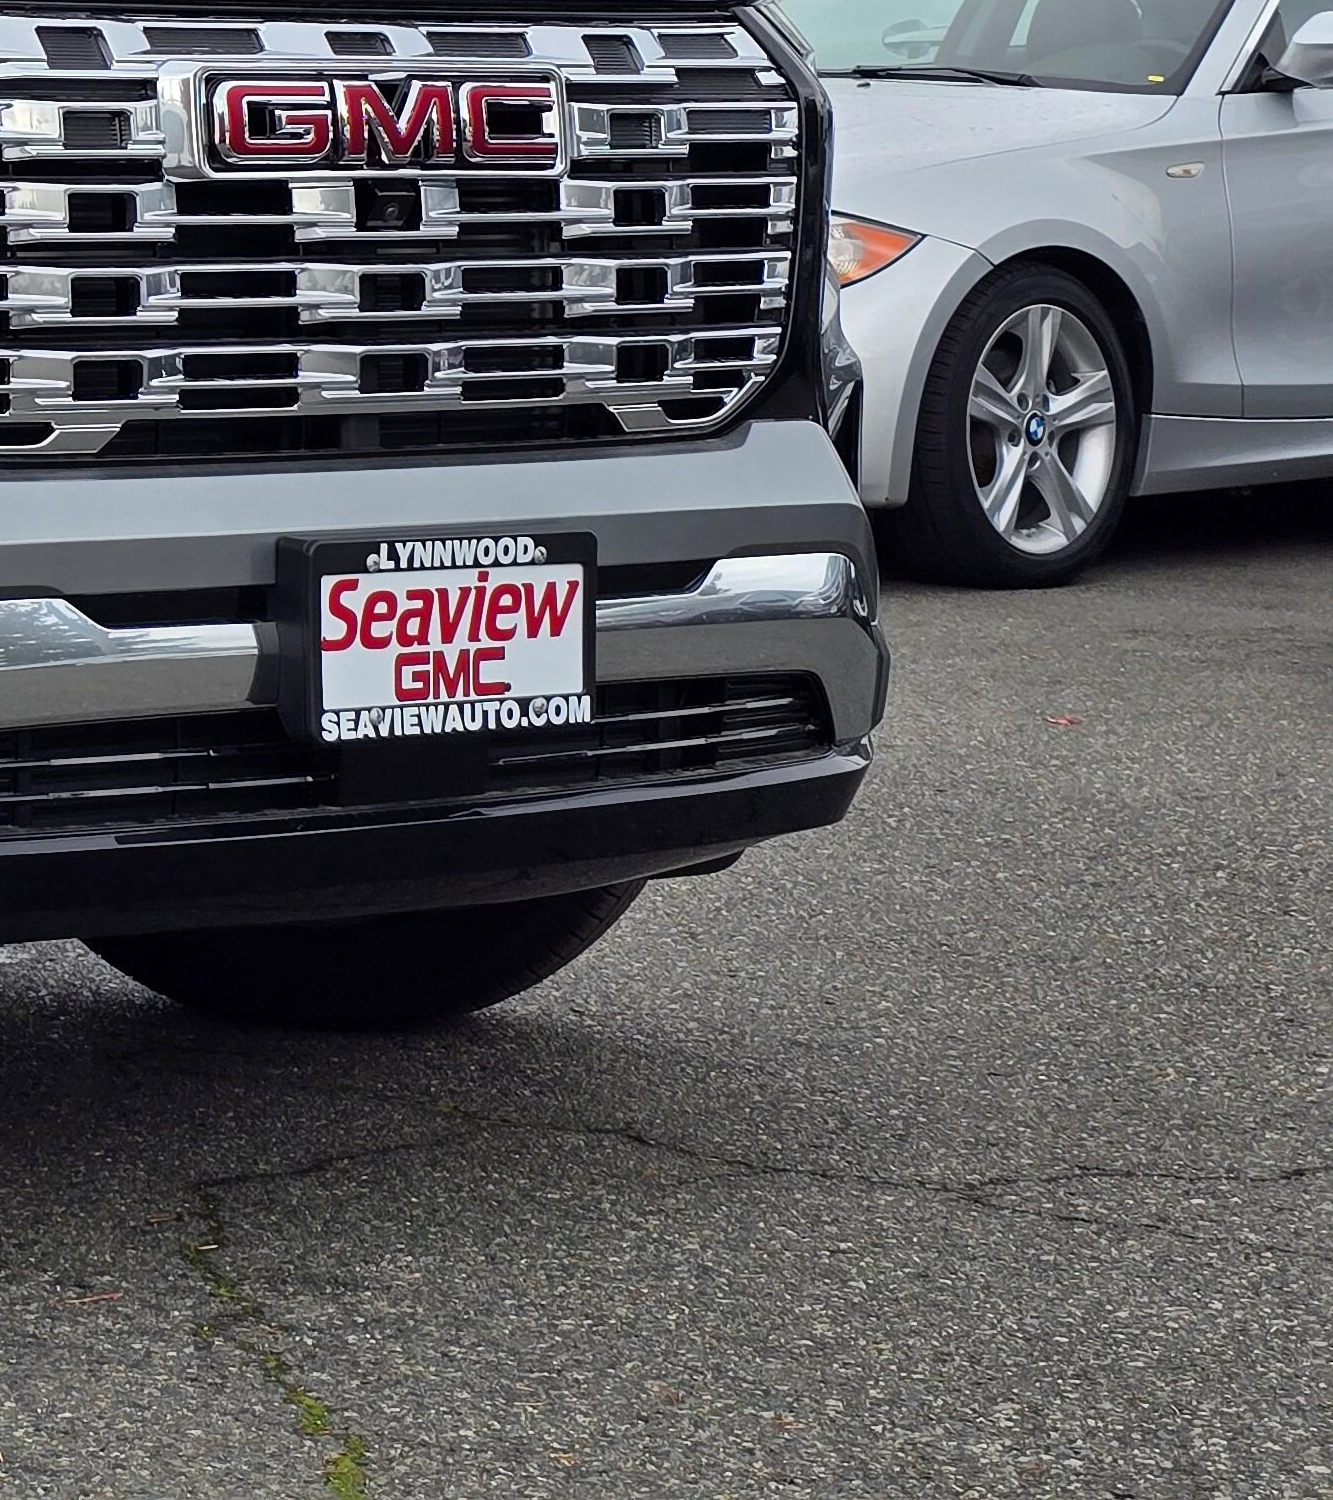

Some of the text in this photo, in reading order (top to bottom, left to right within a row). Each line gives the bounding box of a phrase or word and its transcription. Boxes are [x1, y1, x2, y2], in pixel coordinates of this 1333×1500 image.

[213, 79, 559, 165] GMC
[379, 537, 536, 570] LYNNWOOD
[320, 570, 580, 652] Seaview
[394, 646, 510, 702] GMC
[321, 695, 591, 742] SEAVIEWAUTO.COM
